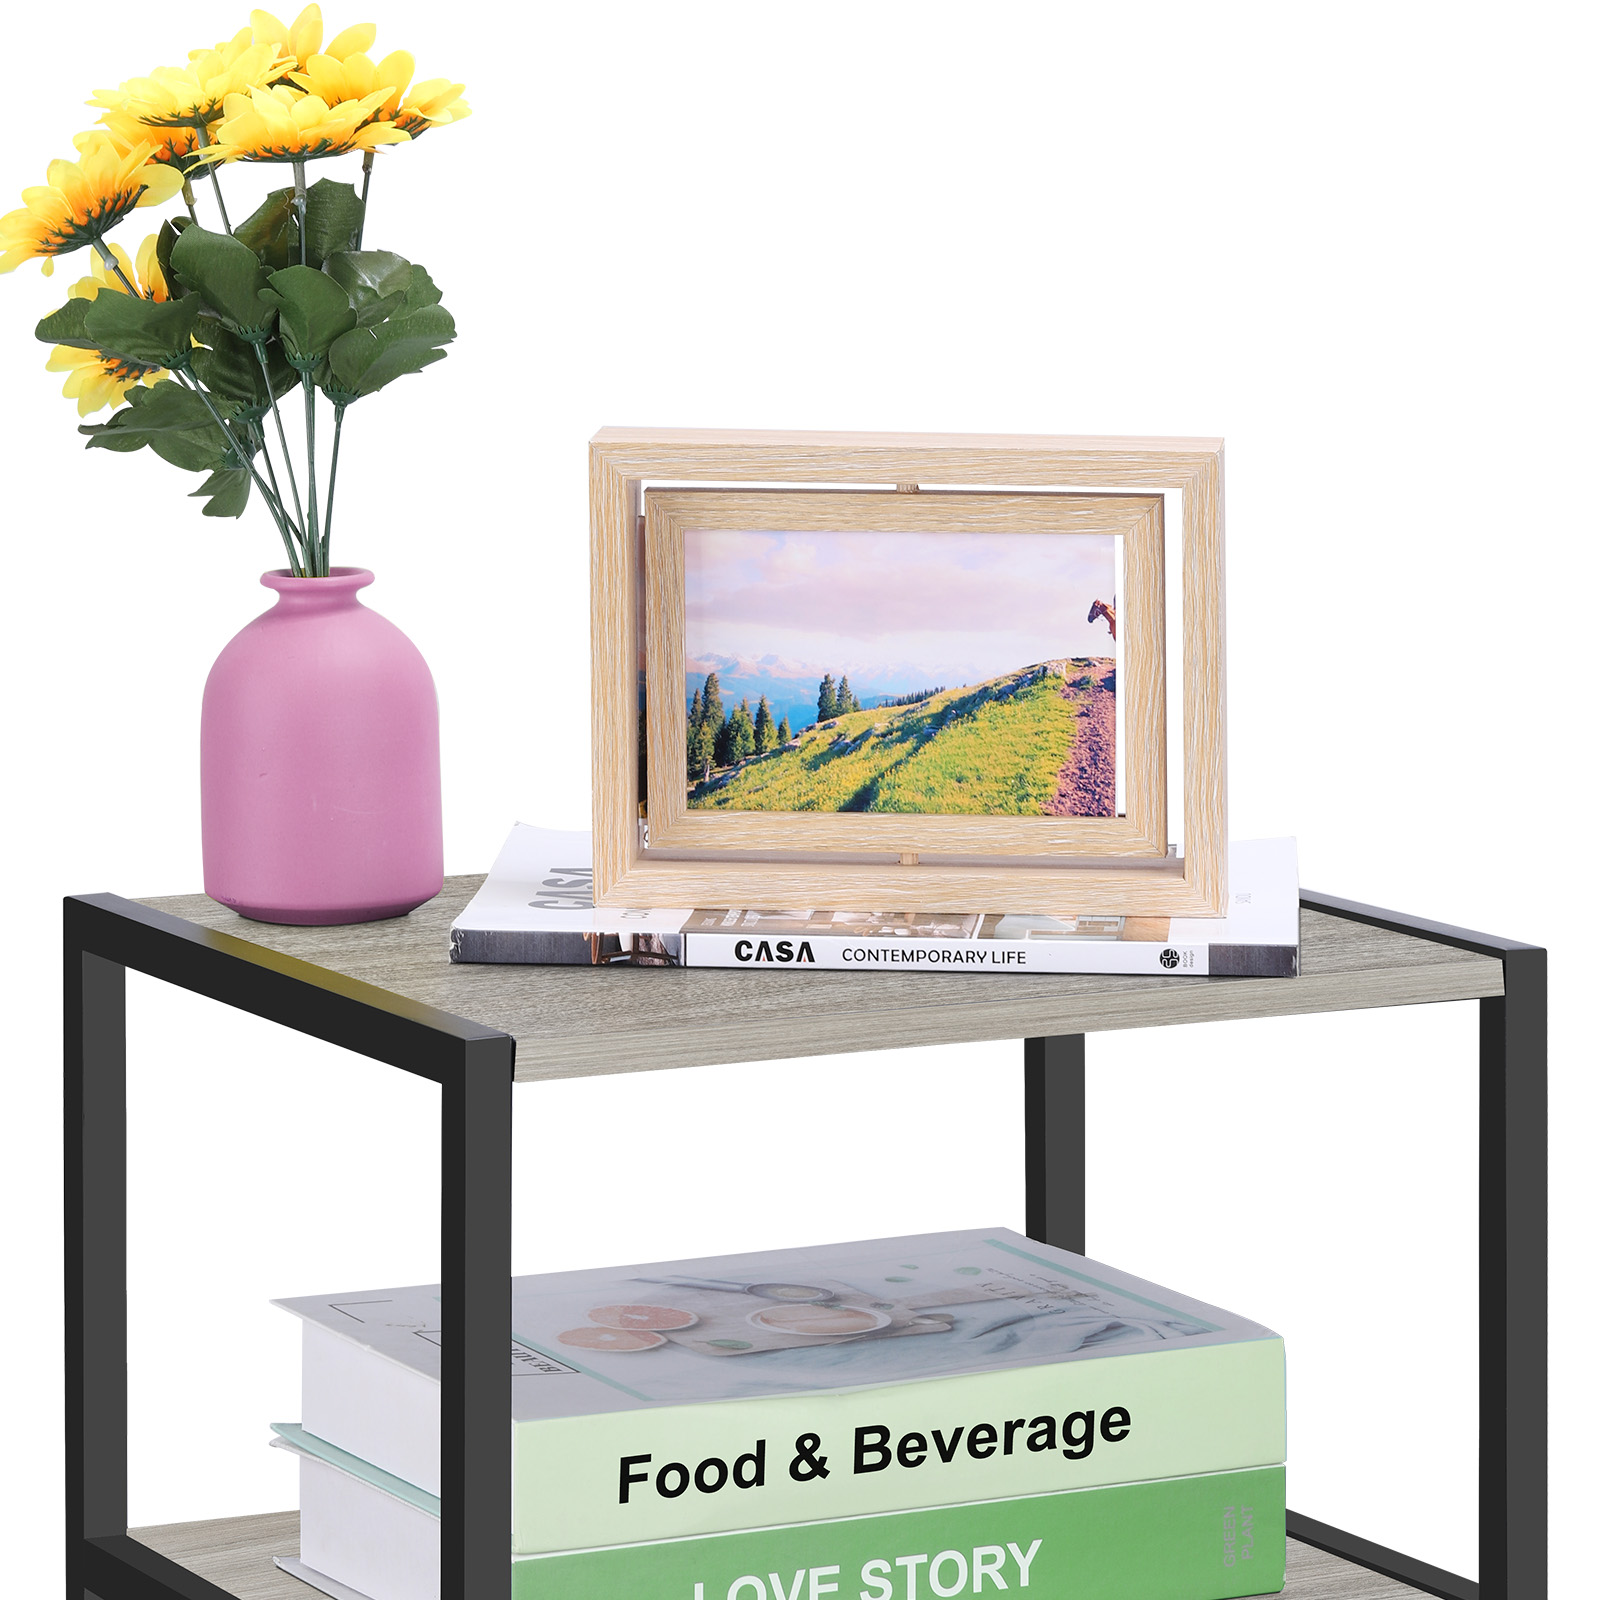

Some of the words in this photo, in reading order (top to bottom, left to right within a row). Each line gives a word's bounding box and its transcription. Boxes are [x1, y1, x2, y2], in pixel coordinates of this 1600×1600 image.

[528, 867, 594, 910] CASA
[734, 939, 816, 963] CASA
[842, 947, 987, 964] CONTEMPORARY
[991, 950, 1027, 965] LIFE
[618, 1439, 767, 1505] Food
[788, 1431, 831, 1482] &
[853, 1404, 1132, 1475] Beverage
[1223, 1505, 1236, 1568] GREEN
[1241, 1504, 1254, 1560] PLANT
[859, 1538, 1044, 1600] STORY
